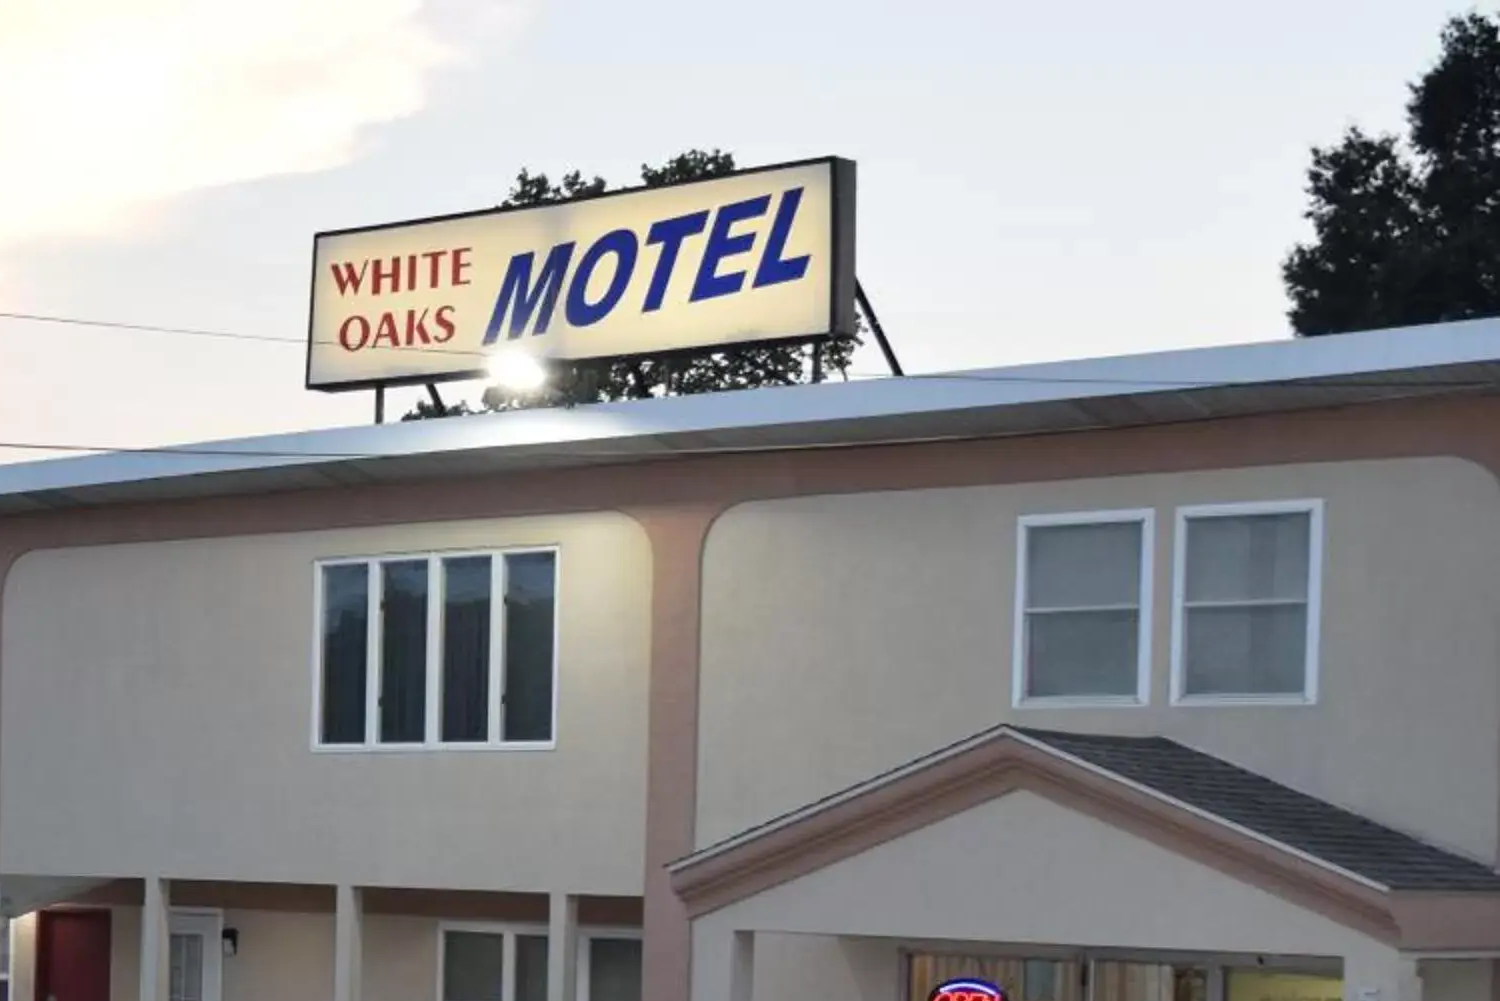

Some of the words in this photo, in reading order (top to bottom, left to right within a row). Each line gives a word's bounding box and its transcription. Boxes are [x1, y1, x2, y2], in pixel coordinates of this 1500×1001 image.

[331, 247, 473, 297] WHITE
[481, 186, 812, 346] MOTEL
[338, 305, 456, 353] OAKS
